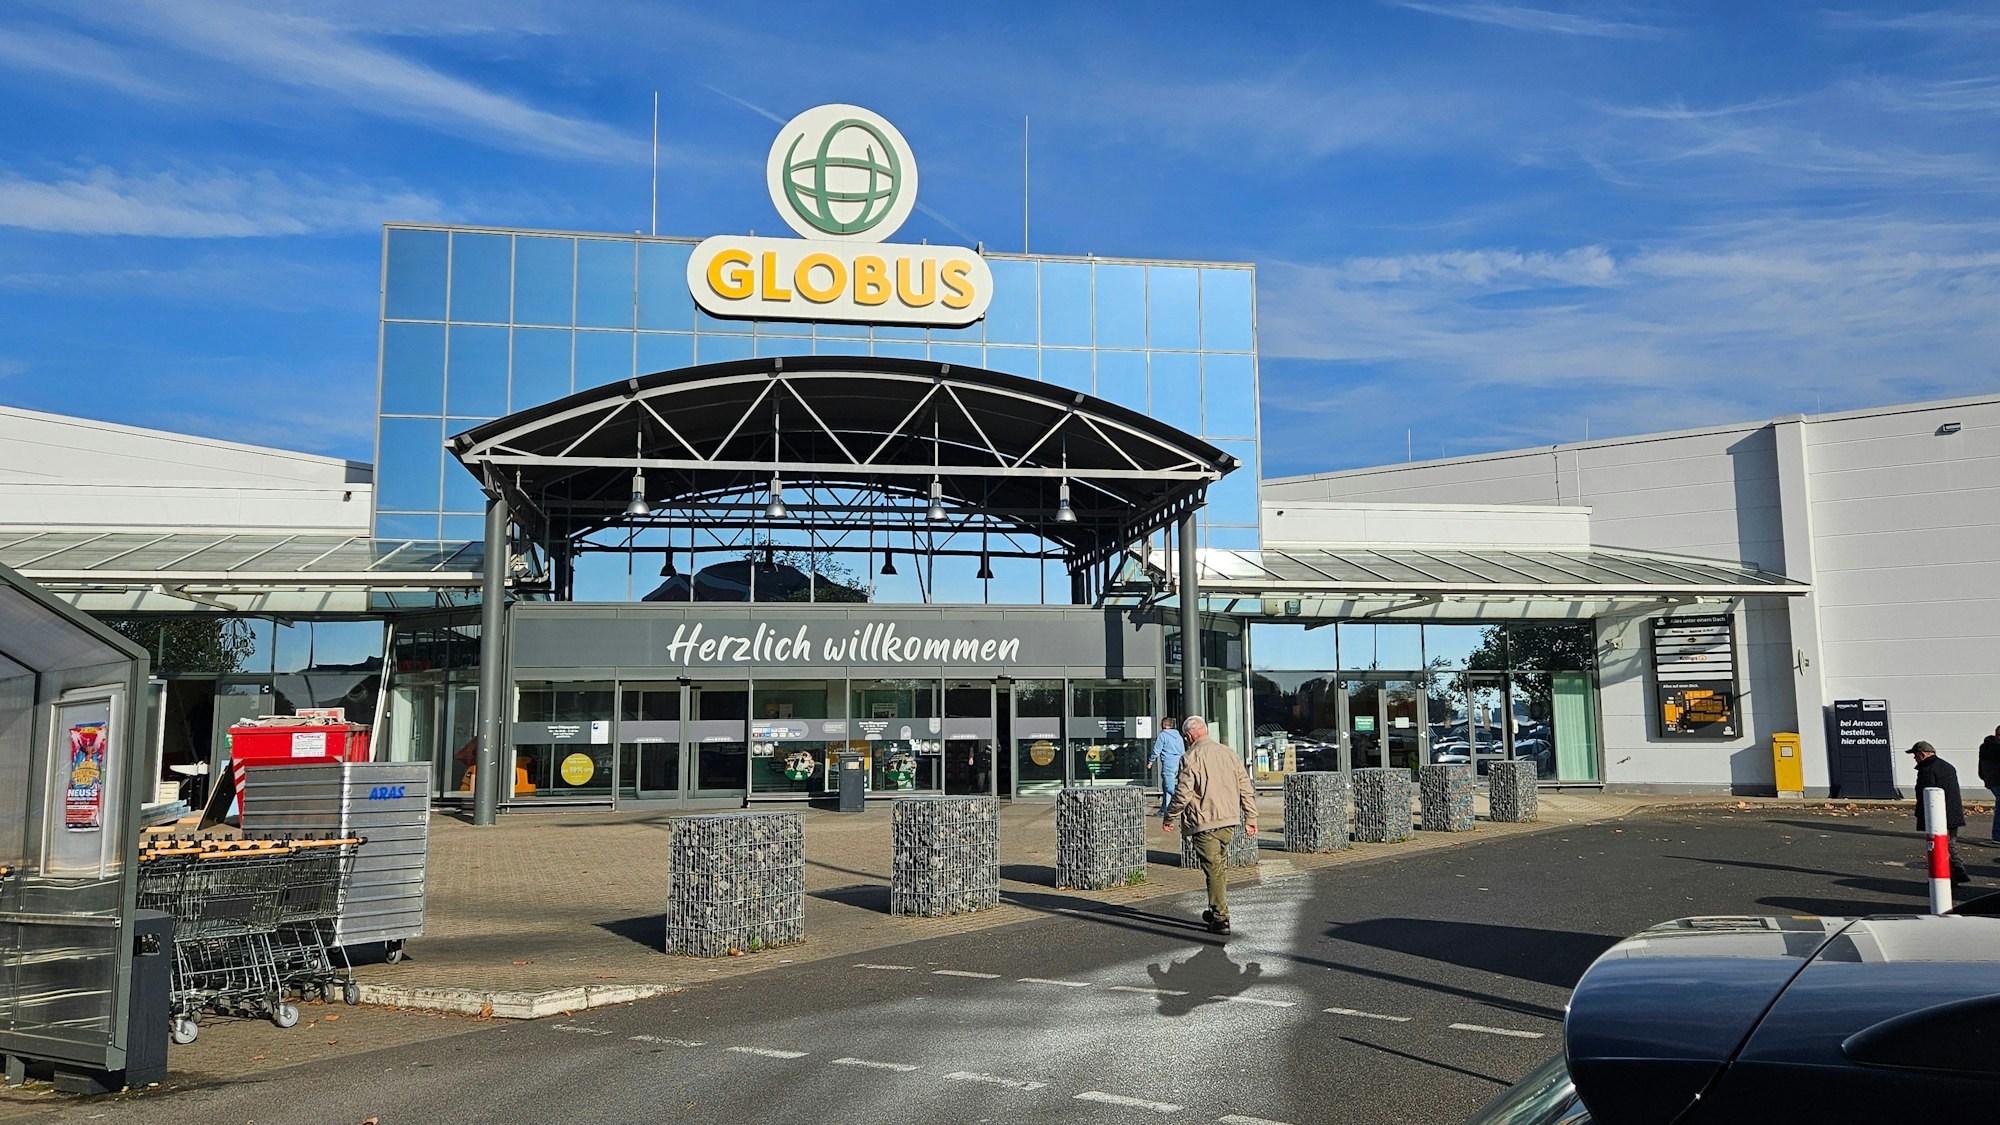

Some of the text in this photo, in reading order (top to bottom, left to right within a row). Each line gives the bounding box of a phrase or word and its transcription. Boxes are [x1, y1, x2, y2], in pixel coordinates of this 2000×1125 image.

[707, 249, 976, 308] GLOBUS
[666, 622, 1020, 666] Herzlich willkommen
[1840, 728, 1876, 737] bestellen,
[1841, 737, 1888, 745] hier abholen
[67, 788, 98, 797] NEUSS
[368, 785, 406, 801] ARAS
